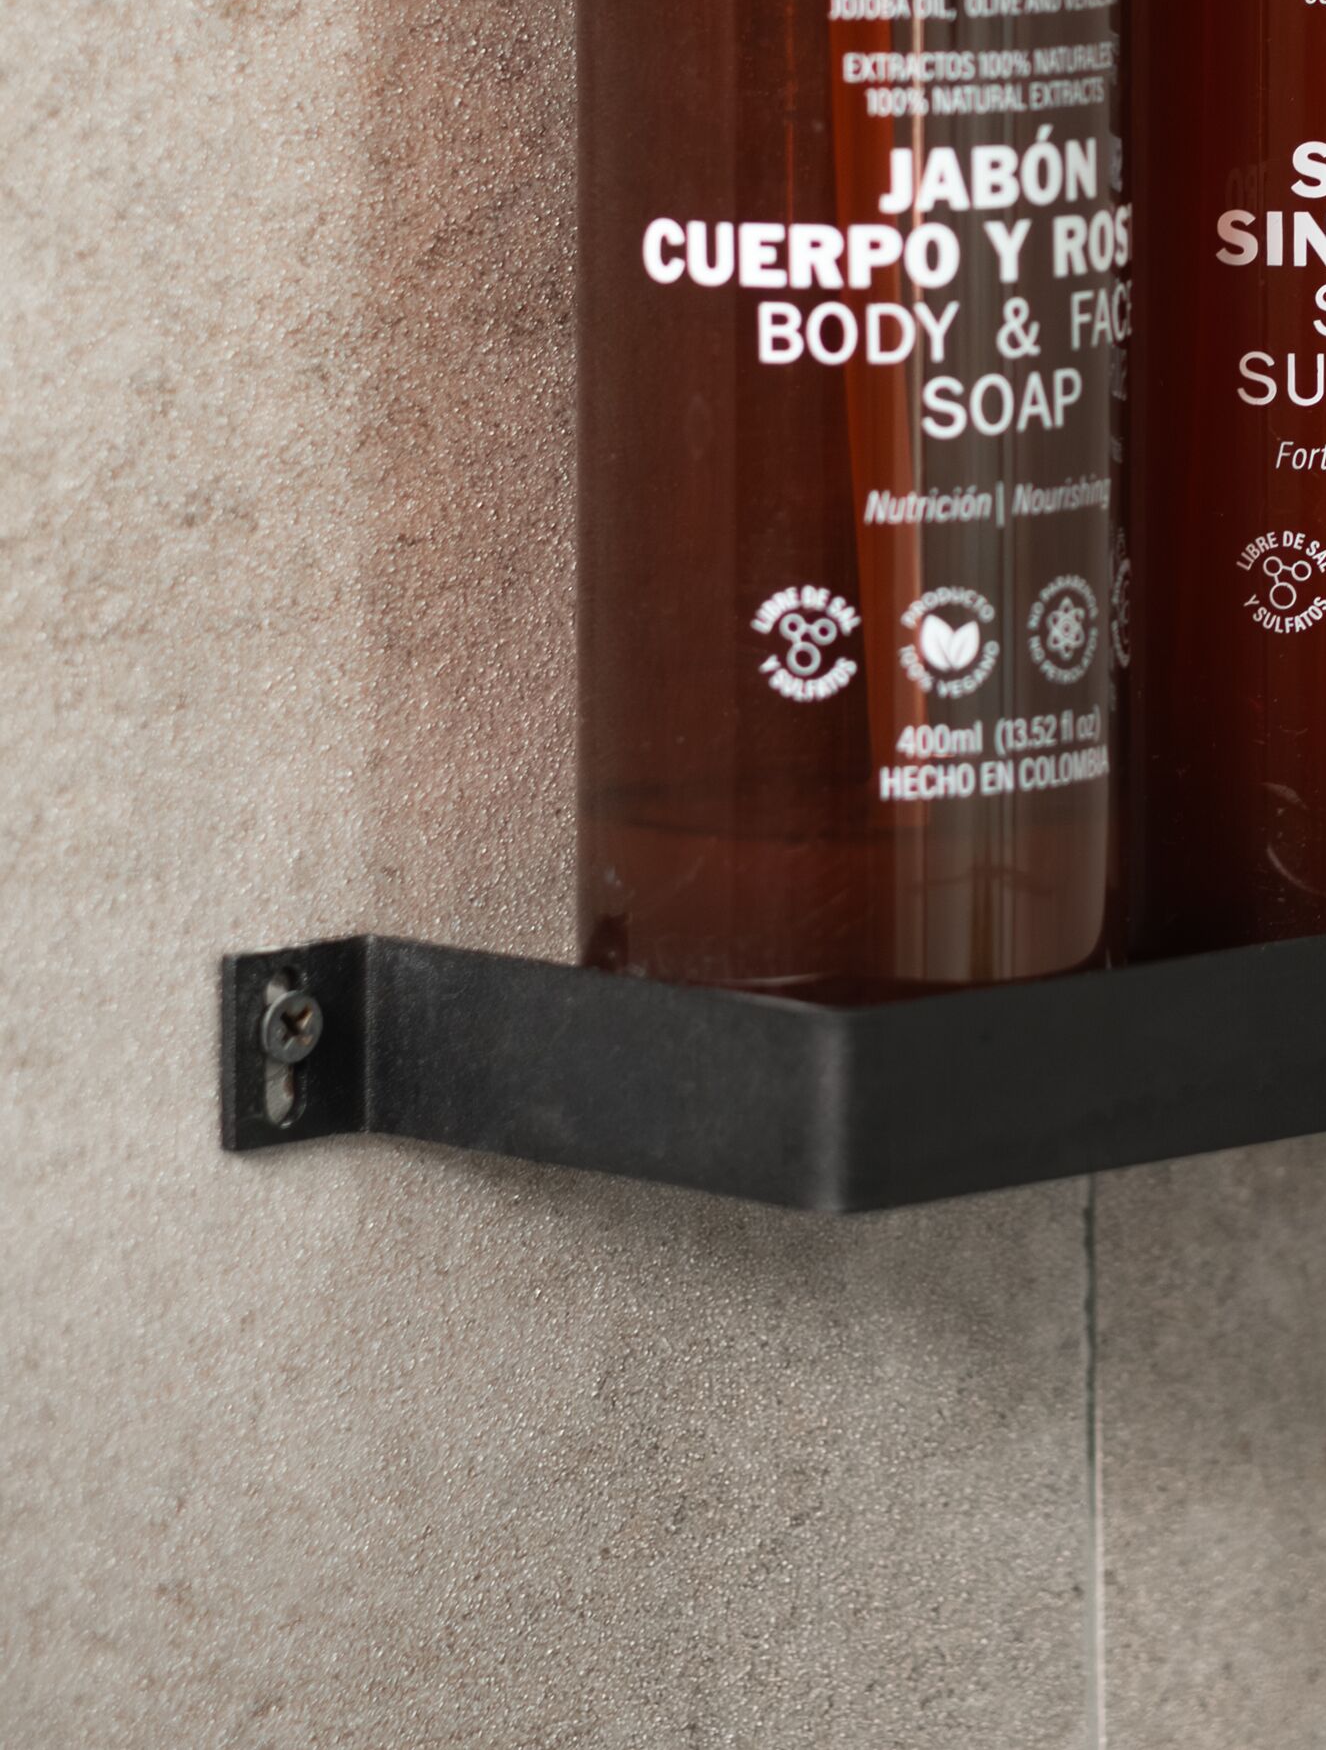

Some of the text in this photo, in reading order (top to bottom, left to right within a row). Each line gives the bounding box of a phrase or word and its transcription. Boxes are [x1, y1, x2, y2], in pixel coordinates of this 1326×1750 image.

[843, 51, 976, 83] EXTRACTOS
[978, 49, 1032, 79] 100%
[865, 76, 1104, 117] 100% NATURAL EXTRACTS
[879, 123, 1098, 214] JABÓN
[642, 218, 961, 289] CUERPO
[984, 218, 1031, 284] Y
[757, 301, 960, 365] BODY
[996, 297, 1041, 360] &
[922, 367, 1082, 440] SOAP
[864, 473, 1111, 525] Nutrición Nourishing
[1235, 531, 1279, 571] LIBRE
[1282, 530, 1304, 550] DE
[901, 586, 995, 629] PRODUCTO
[1243, 592, 1260, 609] Y
[936, 640, 1000, 698] VEGANO
[897, 721, 982, 757] 400ml
[995, 715, 1056, 754] (13.52
[880, 745, 1110, 801] HECHO EN COLOMBIA
